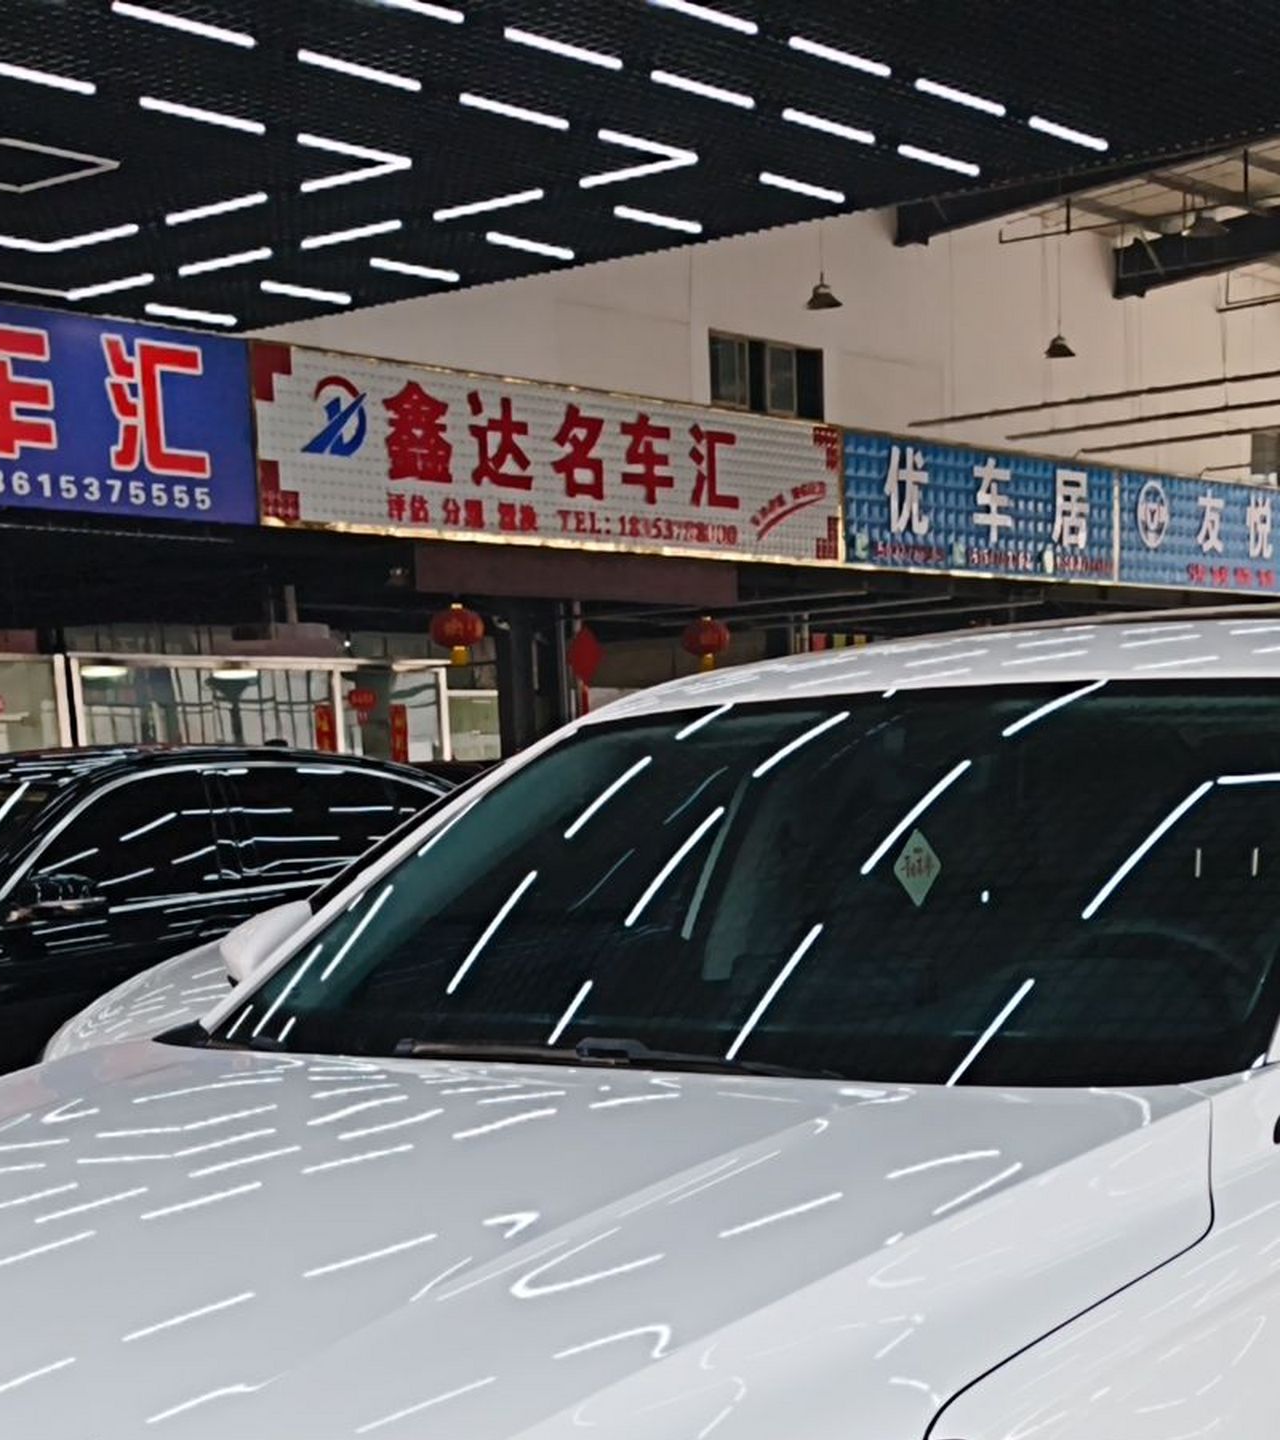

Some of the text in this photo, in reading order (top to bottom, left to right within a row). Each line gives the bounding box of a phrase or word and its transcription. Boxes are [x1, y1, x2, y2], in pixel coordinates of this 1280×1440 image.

[382, 380, 740, 509] 鑫达名车汇
[884, 446, 1089, 549] 优车居
